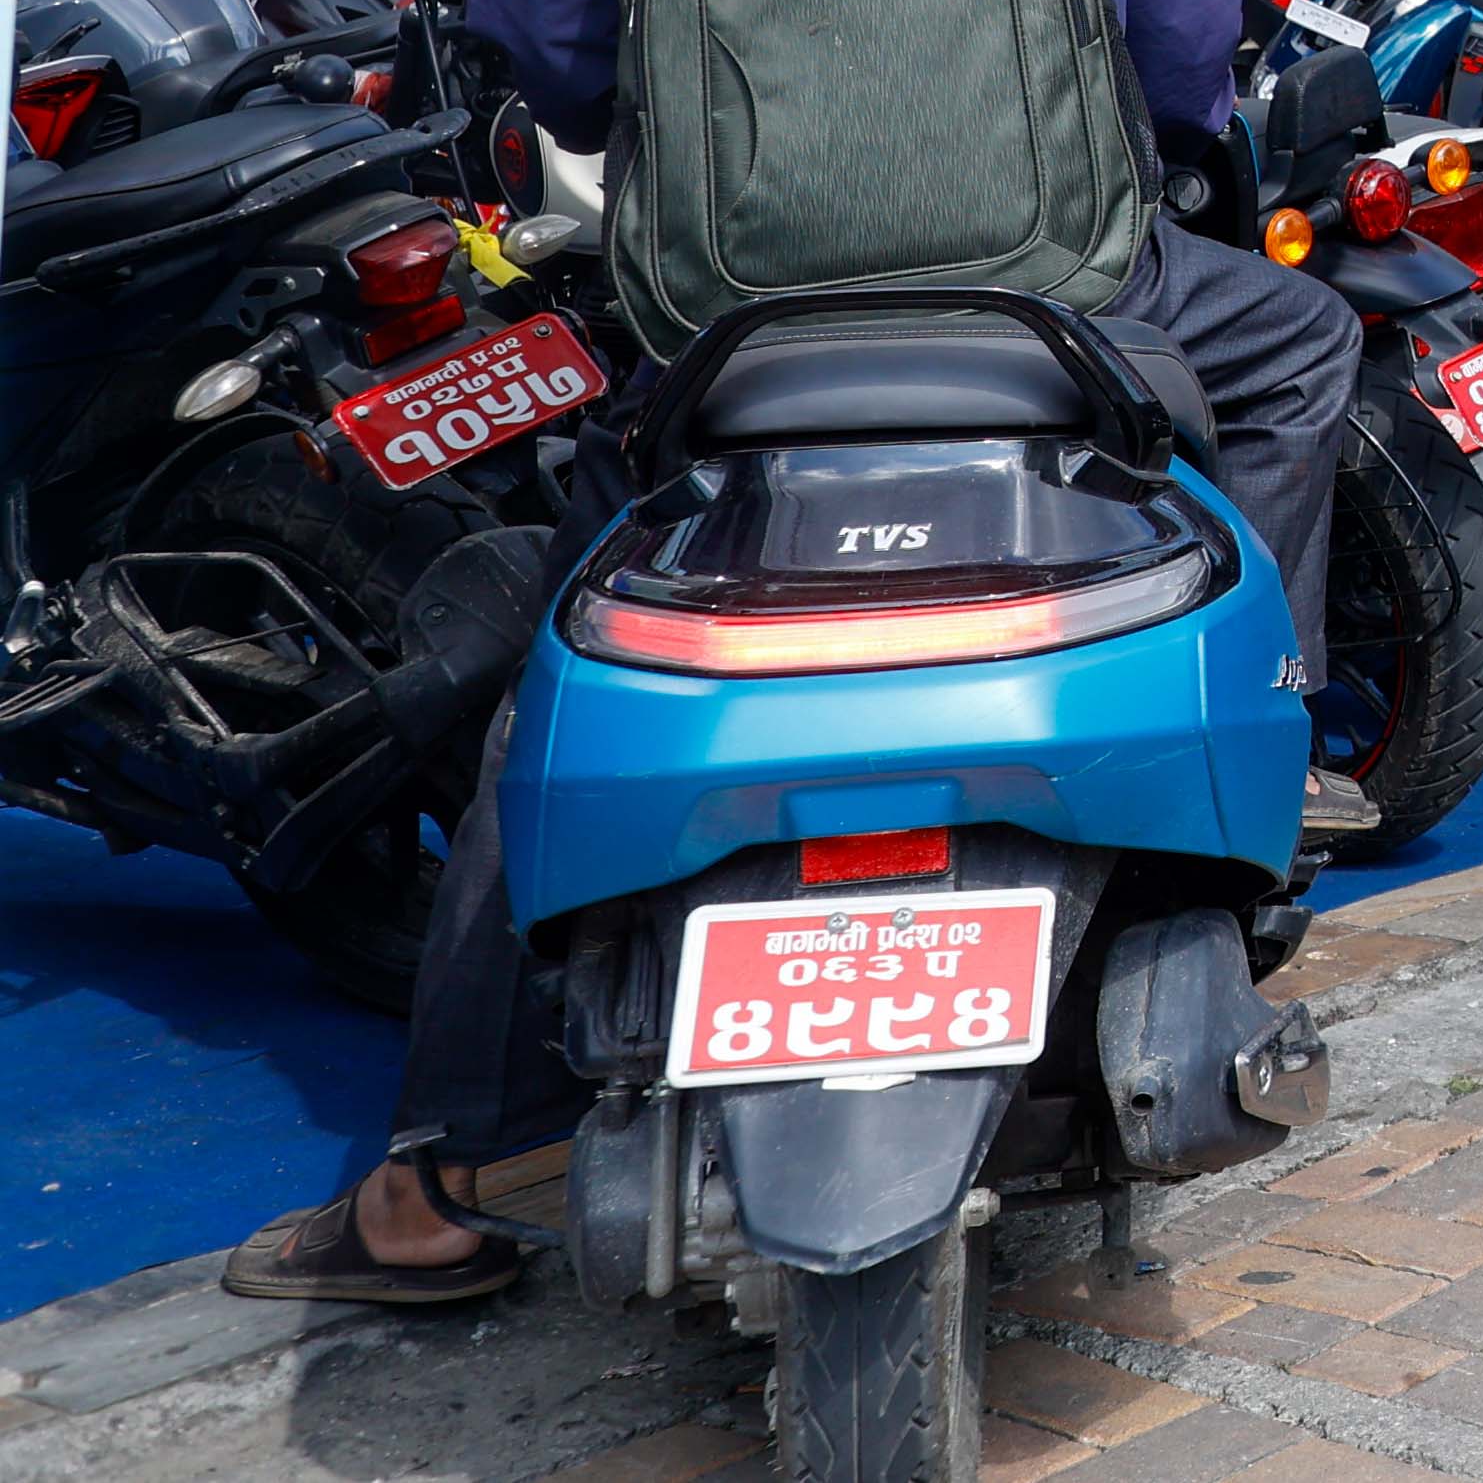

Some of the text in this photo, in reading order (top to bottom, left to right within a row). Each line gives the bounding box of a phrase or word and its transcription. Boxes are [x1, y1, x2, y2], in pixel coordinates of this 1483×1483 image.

[383, 359, 468, 405] बागमती
[837, 521, 932, 554] TVS
[765, 922, 871, 956] बागमती
[947, 922, 981, 945] ०२
[925, 949, 963, 979] प
